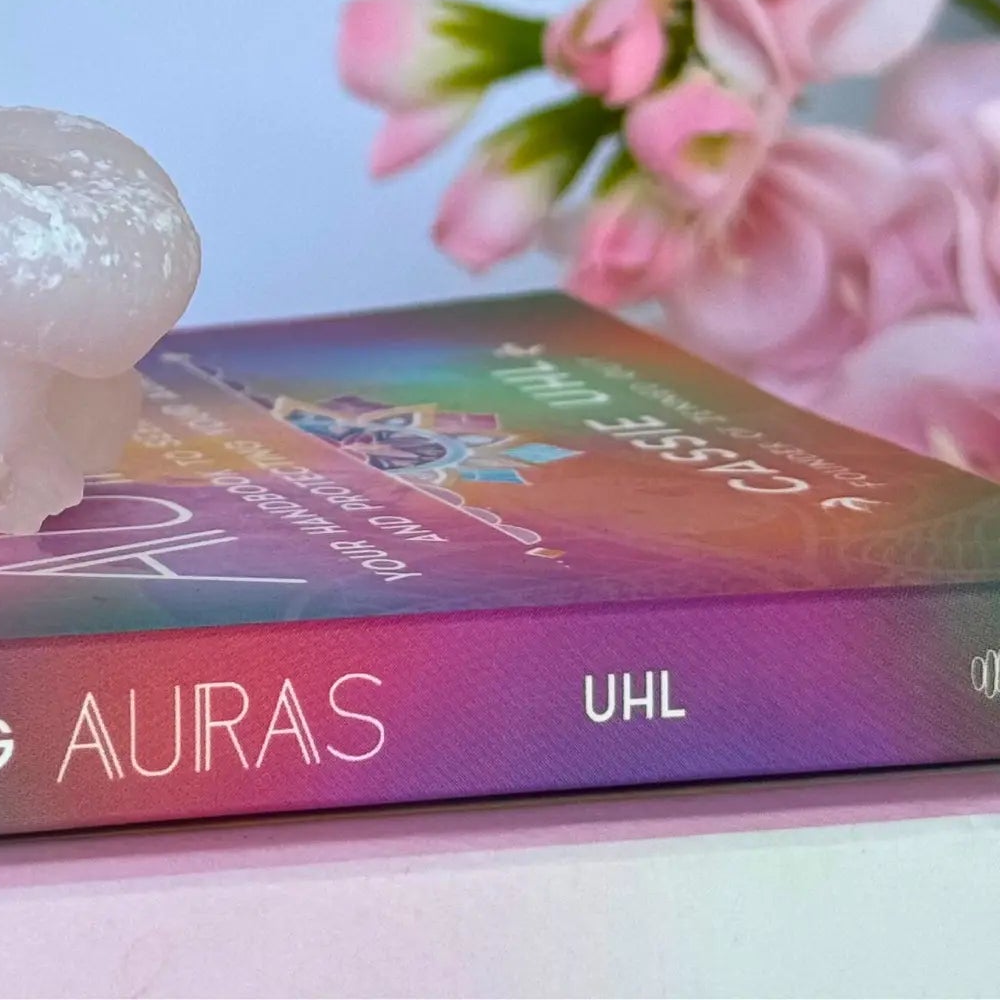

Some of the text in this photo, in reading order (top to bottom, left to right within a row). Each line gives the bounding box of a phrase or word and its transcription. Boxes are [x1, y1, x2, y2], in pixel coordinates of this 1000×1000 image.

[491, 360, 809, 493] CASSIE UHL
[199, 468, 347, 535] HANDBOOK
[224, 440, 386, 511] PROTECTING
[330, 540, 423, 582] YOUR
[368, 515, 447, 543] AND
[57, 673, 386, 783] AURAS
[584, 669, 687, 723] UHL
